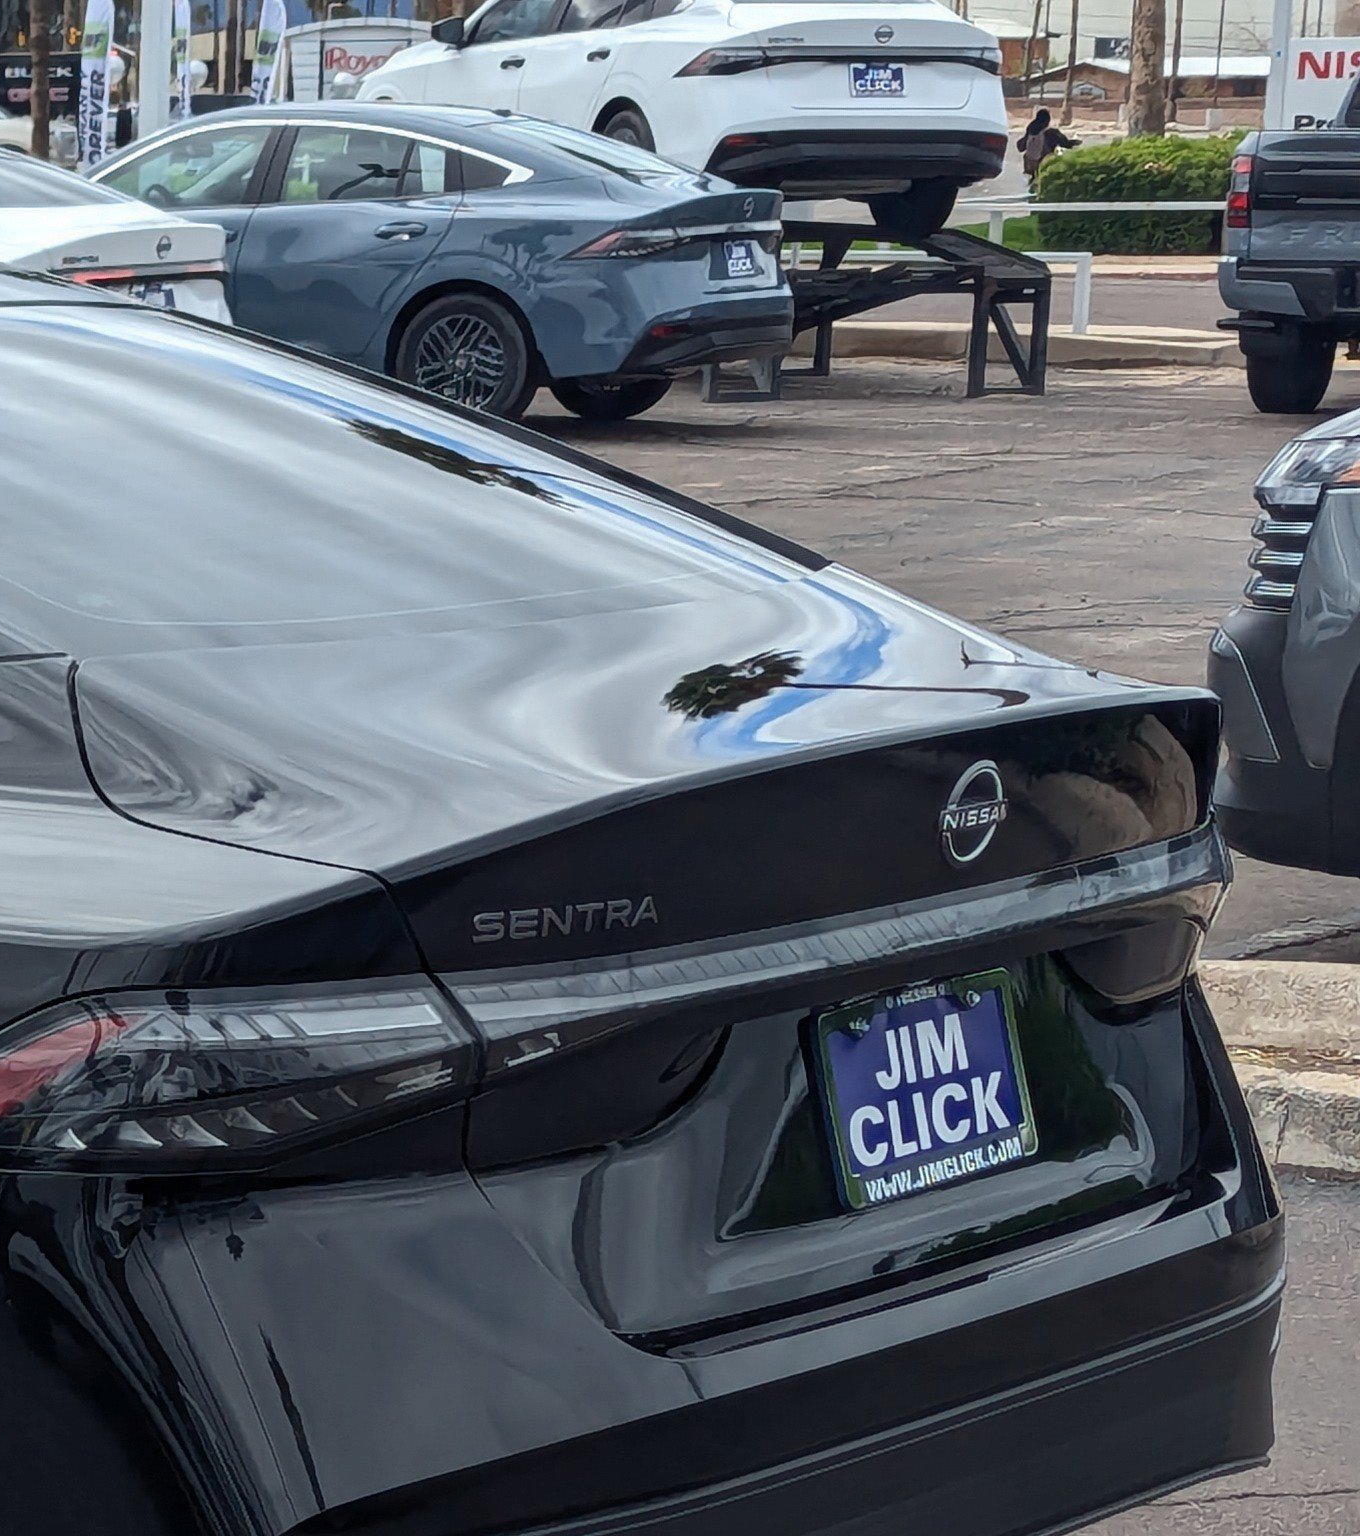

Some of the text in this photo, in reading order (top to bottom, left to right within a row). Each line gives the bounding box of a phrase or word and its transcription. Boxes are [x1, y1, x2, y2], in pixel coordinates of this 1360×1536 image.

[5, 66, 74, 79] BUCK
[472, 896, 659, 944] SENTRA
[874, 1012, 970, 1091] JIM
[849, 1070, 1011, 1168] CLICK
